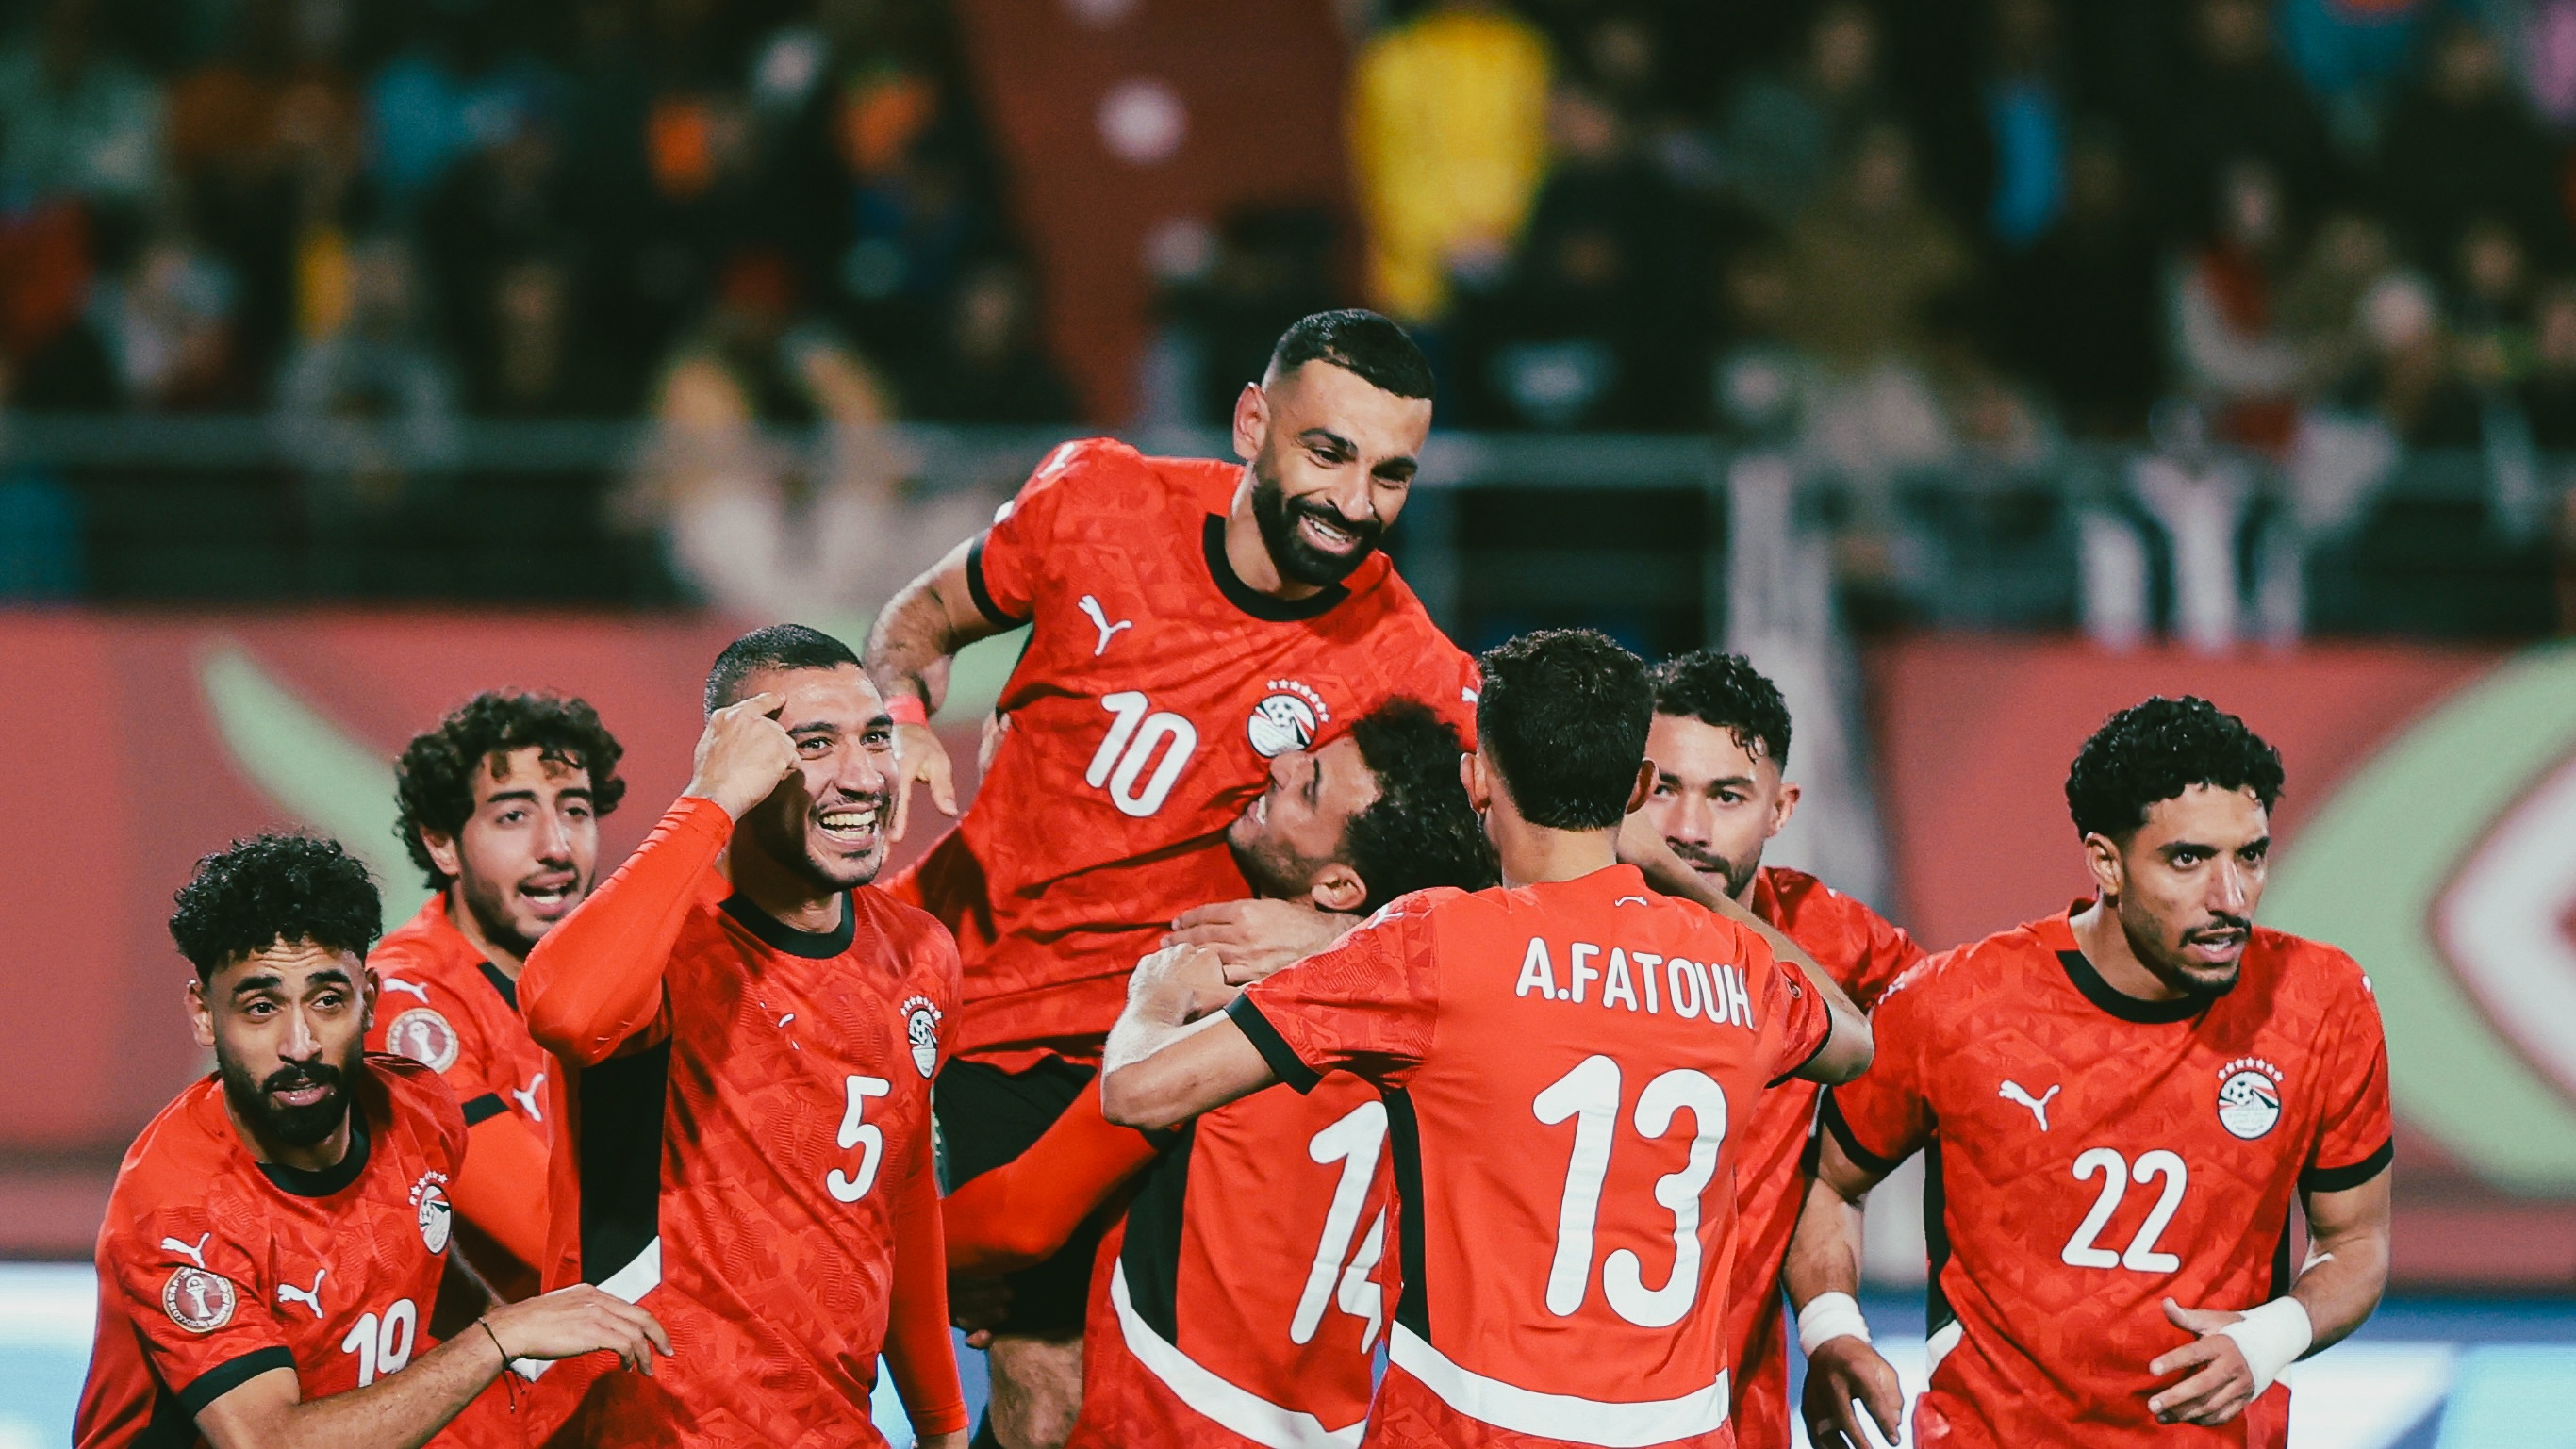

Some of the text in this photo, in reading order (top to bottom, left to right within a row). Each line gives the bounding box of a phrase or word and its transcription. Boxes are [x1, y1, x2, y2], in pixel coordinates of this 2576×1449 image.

[1086, 691, 1197, 817] 10
[1514, 936, 1754, 1029] A.FATOUH
[826, 1074, 890, 1203] 5
[1532, 1054, 1726, 1328] 13
[2061, 1147, 2188, 1274] 22
